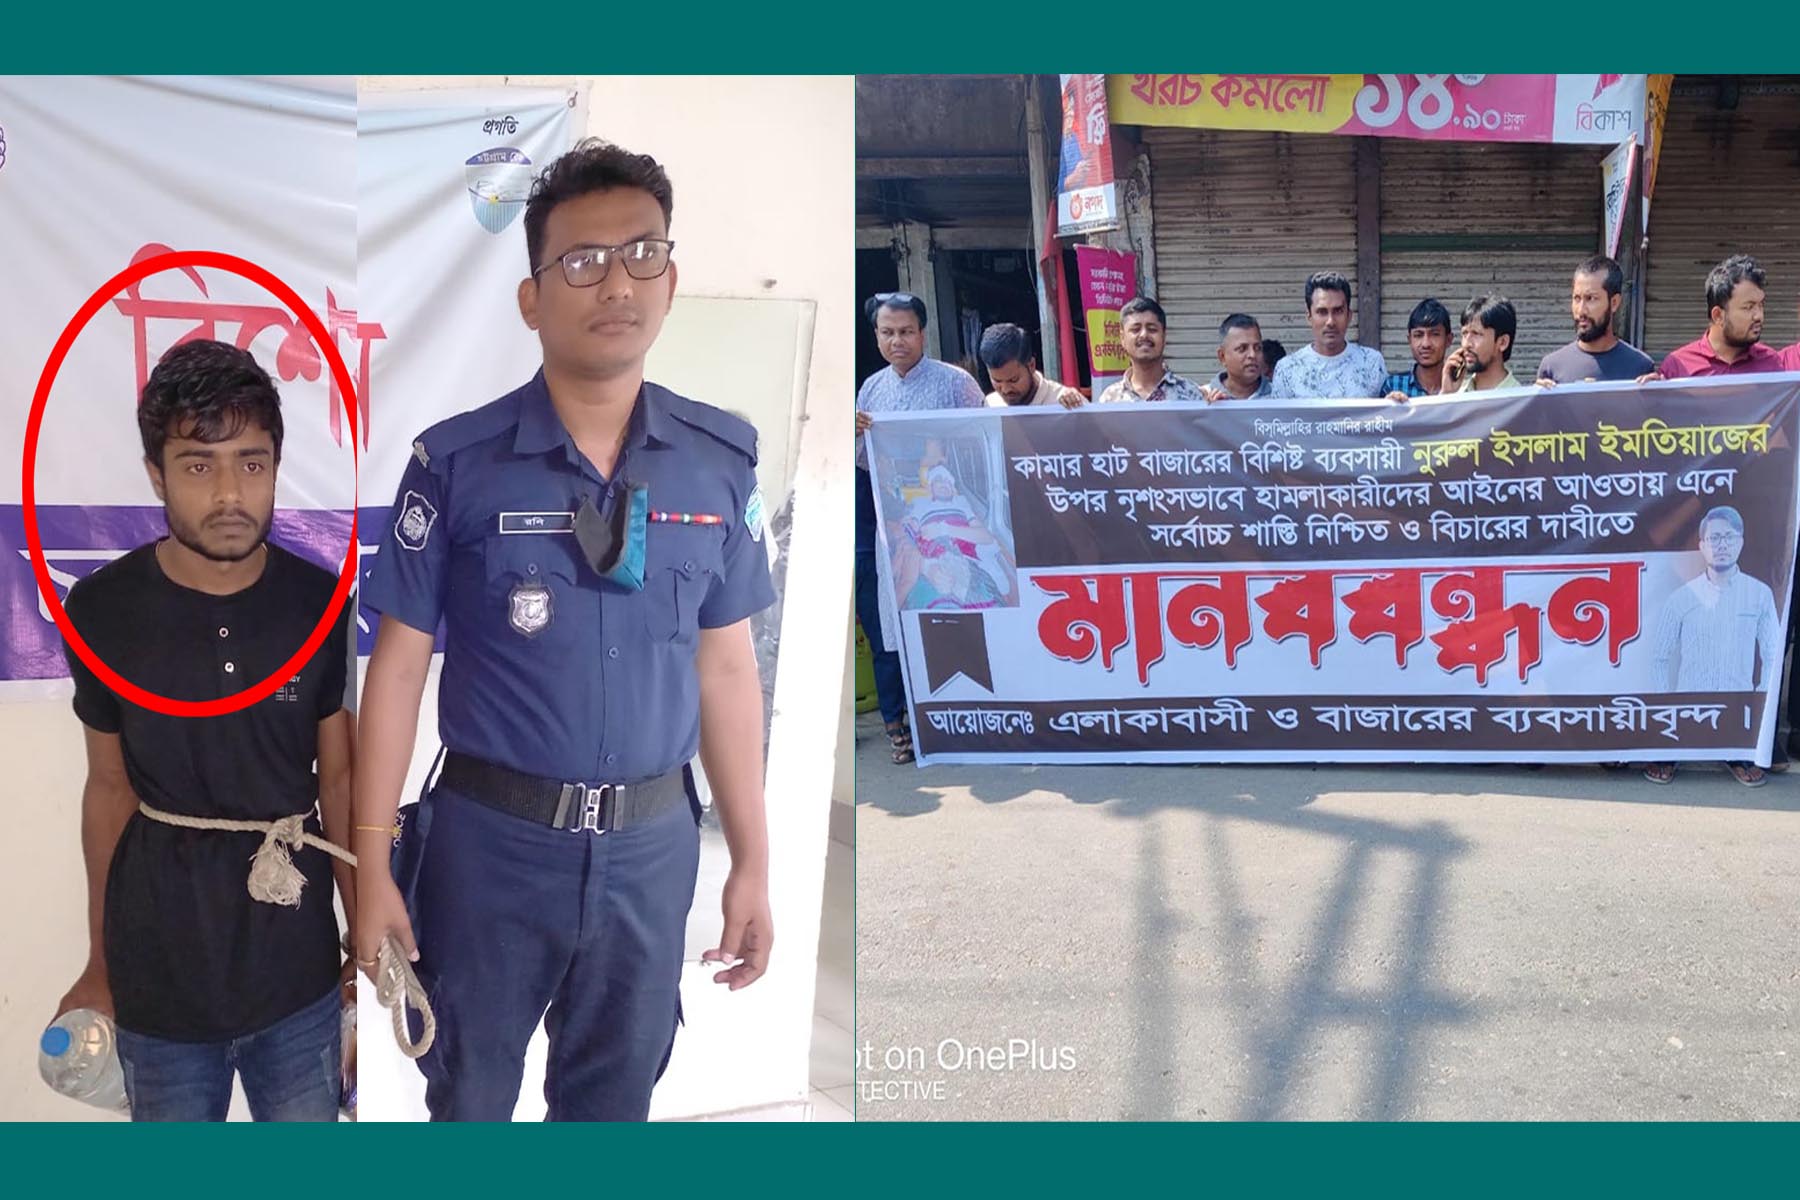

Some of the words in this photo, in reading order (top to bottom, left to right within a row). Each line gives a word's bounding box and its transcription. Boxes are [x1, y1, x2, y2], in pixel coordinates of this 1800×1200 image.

[483, 115, 519, 136] প্রগতি
[1576, 103, 1632, 131] বিকাশ
[1011, 452, 1082, 479] কামার
[1089, 445, 1131, 477] হাট
[1137, 448, 1233, 476] বাজারের
[1239, 441, 1305, 472] বিশিষ্ট
[1312, 437, 1405, 473] ব্যবসায়ী
[1410, 438, 1483, 477] নুরুল
[1489, 427, 1590, 467] ইসলাম
[1596, 418, 1772, 462] ইমতিয়াজের
[1046, 484, 1109, 513] উপর
[1114, 486, 1247, 521] নৃশংসভাবে
[1252, 475, 1434, 512] হামলাকারীদের
[1438, 471, 1547, 506] আইনের
[1552, 470, 1668, 500] আওতায়
[1675, 468, 1739, 496] এনে
[1148, 516, 1234, 548] সর্বোচ্চ
[1240, 514, 1300, 547] শাস্তি
[1304, 512, 1392, 546] নিশ্চিত
[1399, 520, 1421, 541] ও
[1428, 510, 1532, 542] বিচারের
[1537, 504, 1638, 540] দাবীতে
[1030, 561, 1647, 688] মানববন্ধন
[926, 707, 1034, 735] আয়োজনেঃ
[1049, 698, 1255, 736] এলাকাবাসী
[1267, 709, 1300, 731] ও
[1311, 703, 1479, 733] বাজারের
[1487, 696, 1727, 741] ব্যবসায়ীবৃন্দ
